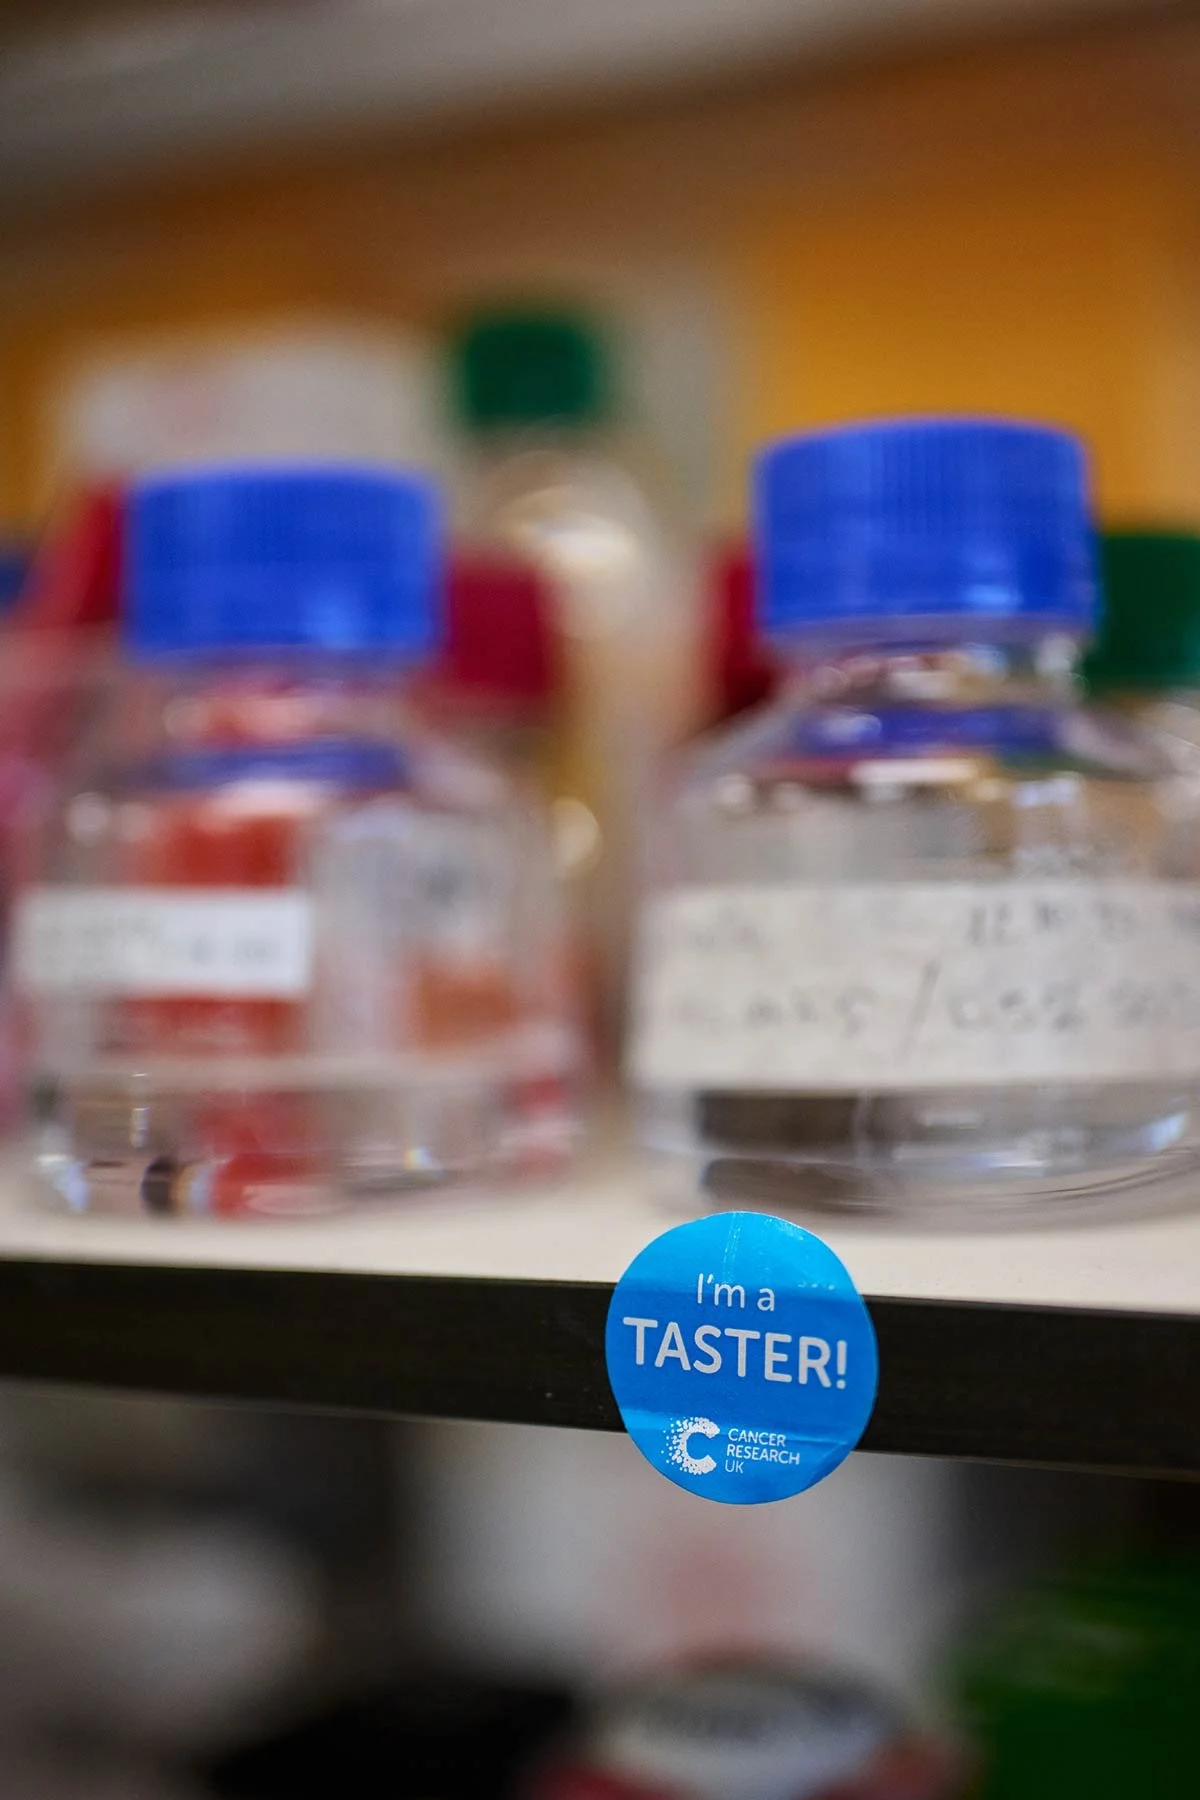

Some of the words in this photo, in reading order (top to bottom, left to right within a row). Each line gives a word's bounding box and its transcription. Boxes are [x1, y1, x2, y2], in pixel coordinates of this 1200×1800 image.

[757, 1287, 776, 1311] a
[623, 1316, 848, 1389] TASTER!
[727, 1428, 787, 1447] CANCER
[726, 1444, 800, 1465] RESEARCH
[724, 1458, 744, 1473] UK
